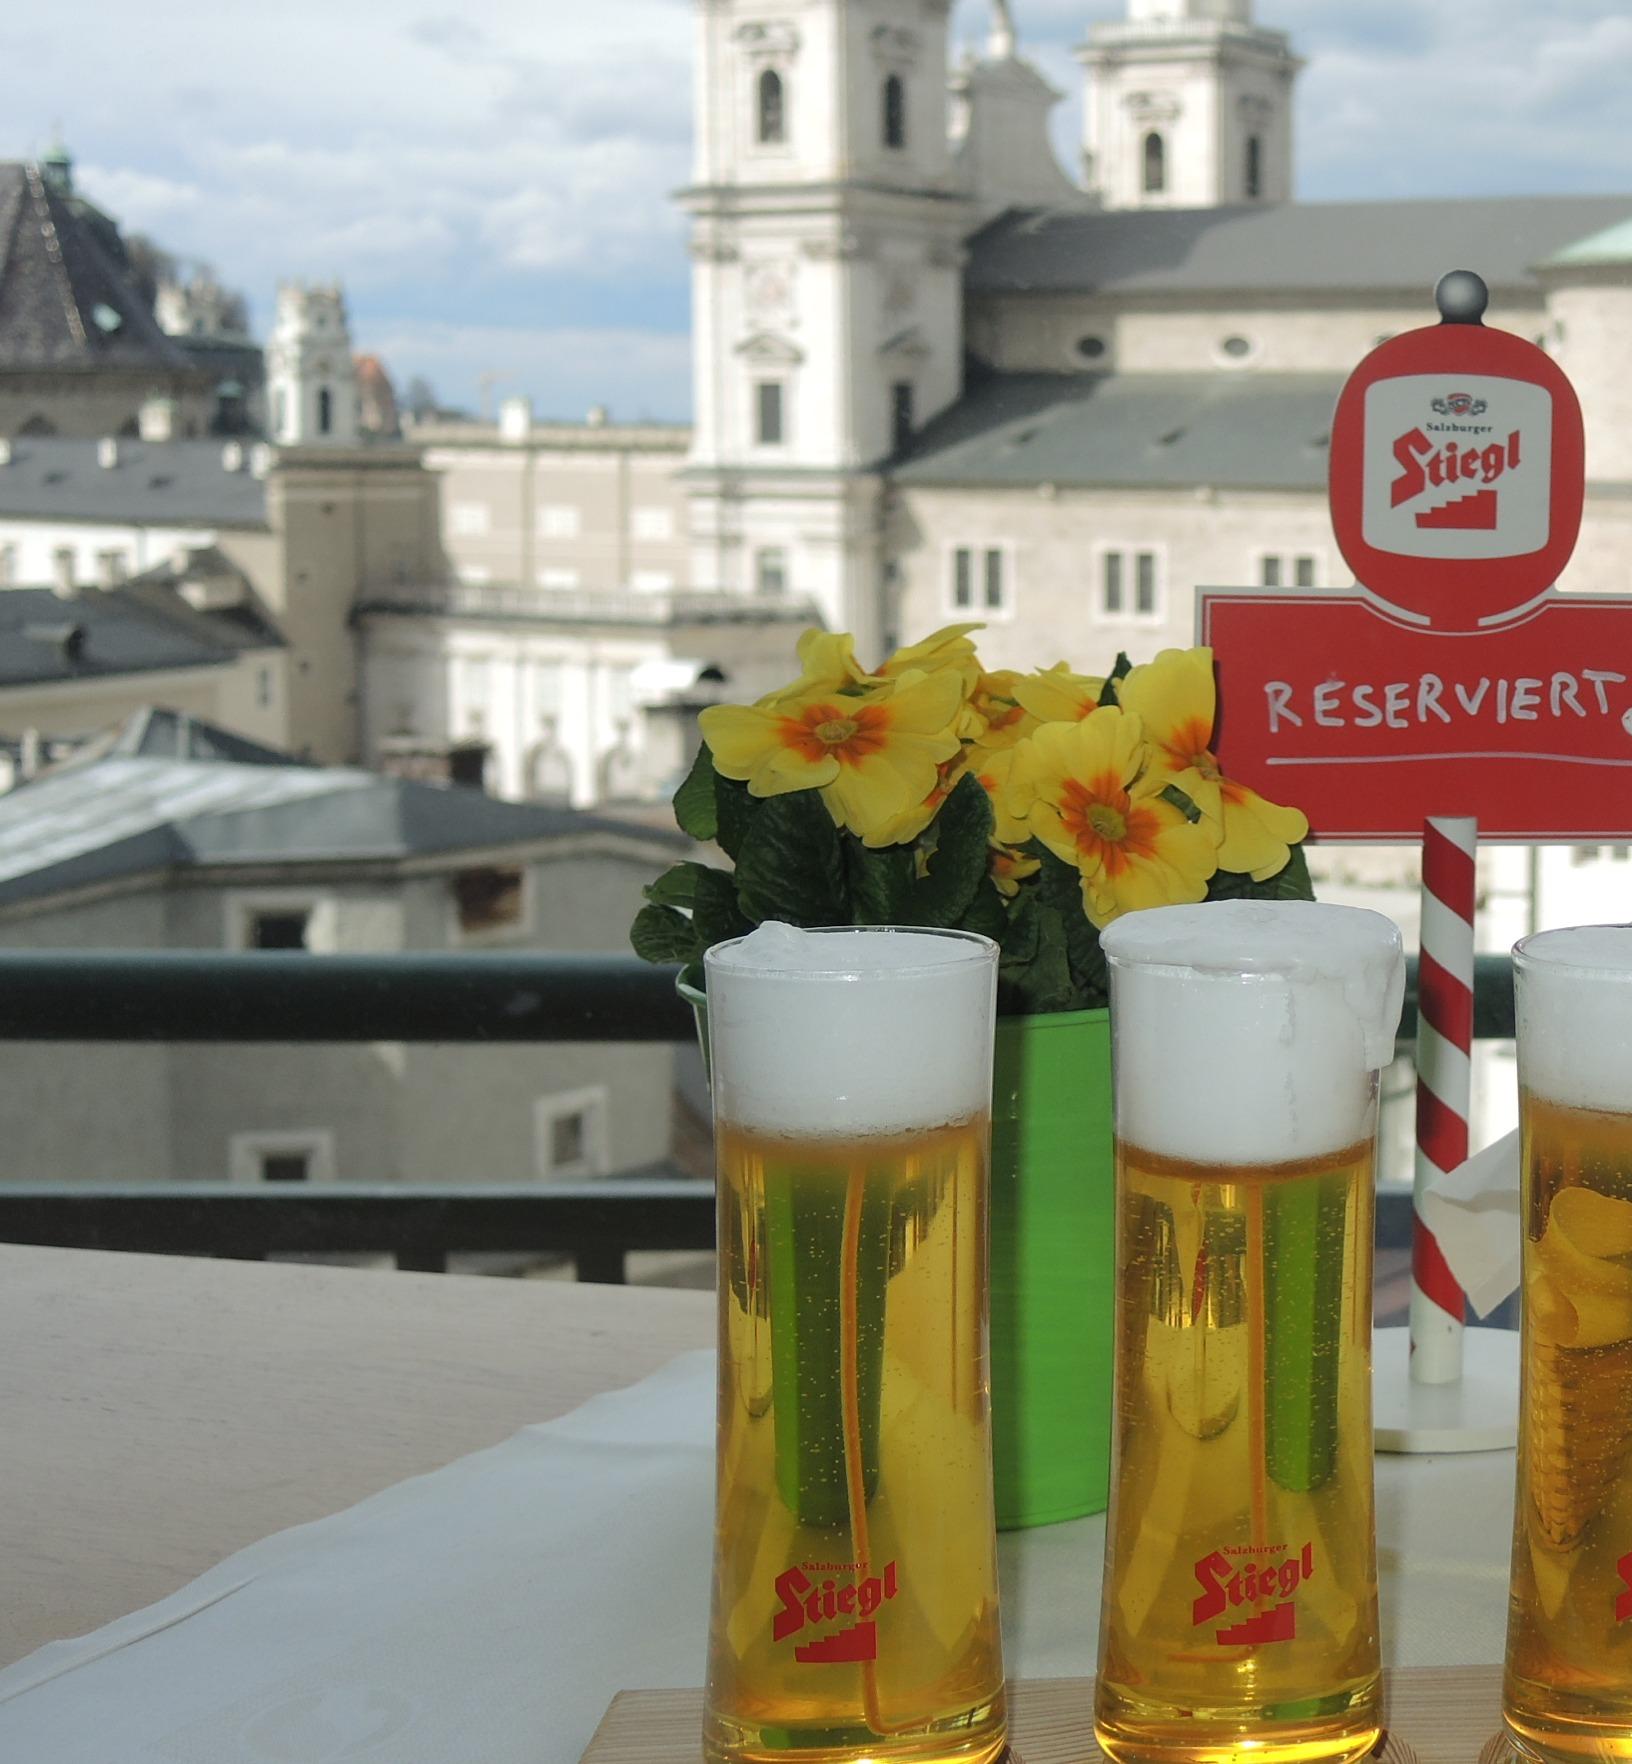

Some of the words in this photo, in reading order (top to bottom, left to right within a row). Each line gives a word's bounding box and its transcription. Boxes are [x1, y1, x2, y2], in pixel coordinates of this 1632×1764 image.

[1426, 422, 1493, 435] Salzburger
[1391, 427, 1521, 509] Stiegl
[1264, 669, 1626, 733] RESERVIERT
[801, 1561, 868, 1573] Salzburger
[1223, 1543, 1288, 1555] Salzburger
[773, 1560, 898, 1642] Stiegl
[1193, 1541, 1314, 1626] Stiegl
